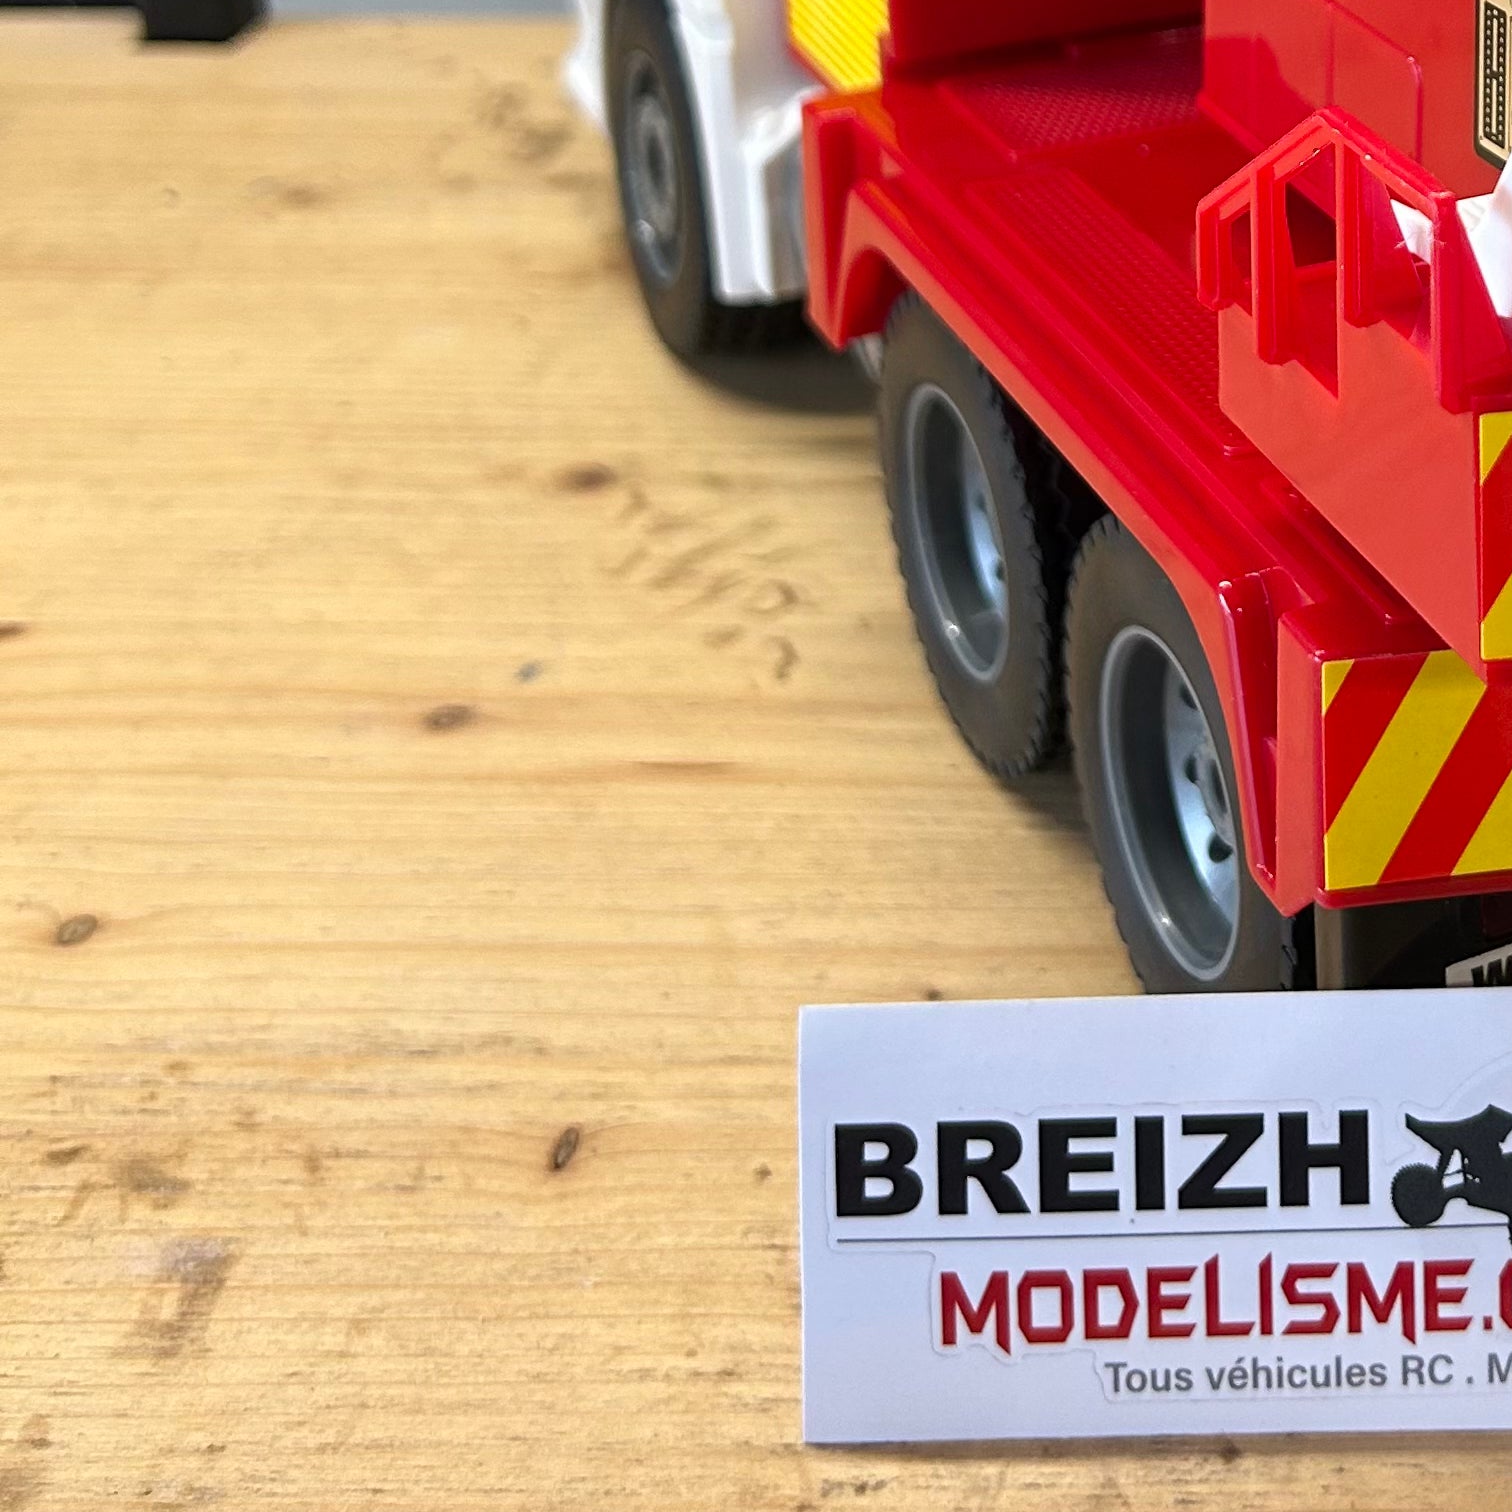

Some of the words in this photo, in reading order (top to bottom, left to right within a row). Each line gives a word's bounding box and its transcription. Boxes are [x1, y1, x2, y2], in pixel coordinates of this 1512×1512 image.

[834, 1110, 1370, 1218] BREIZH
[1104, 1361, 1194, 1394] Tous
[1205, 1355, 1388, 1391] véhicules
[1401, 1354, 1453, 1386] RC
